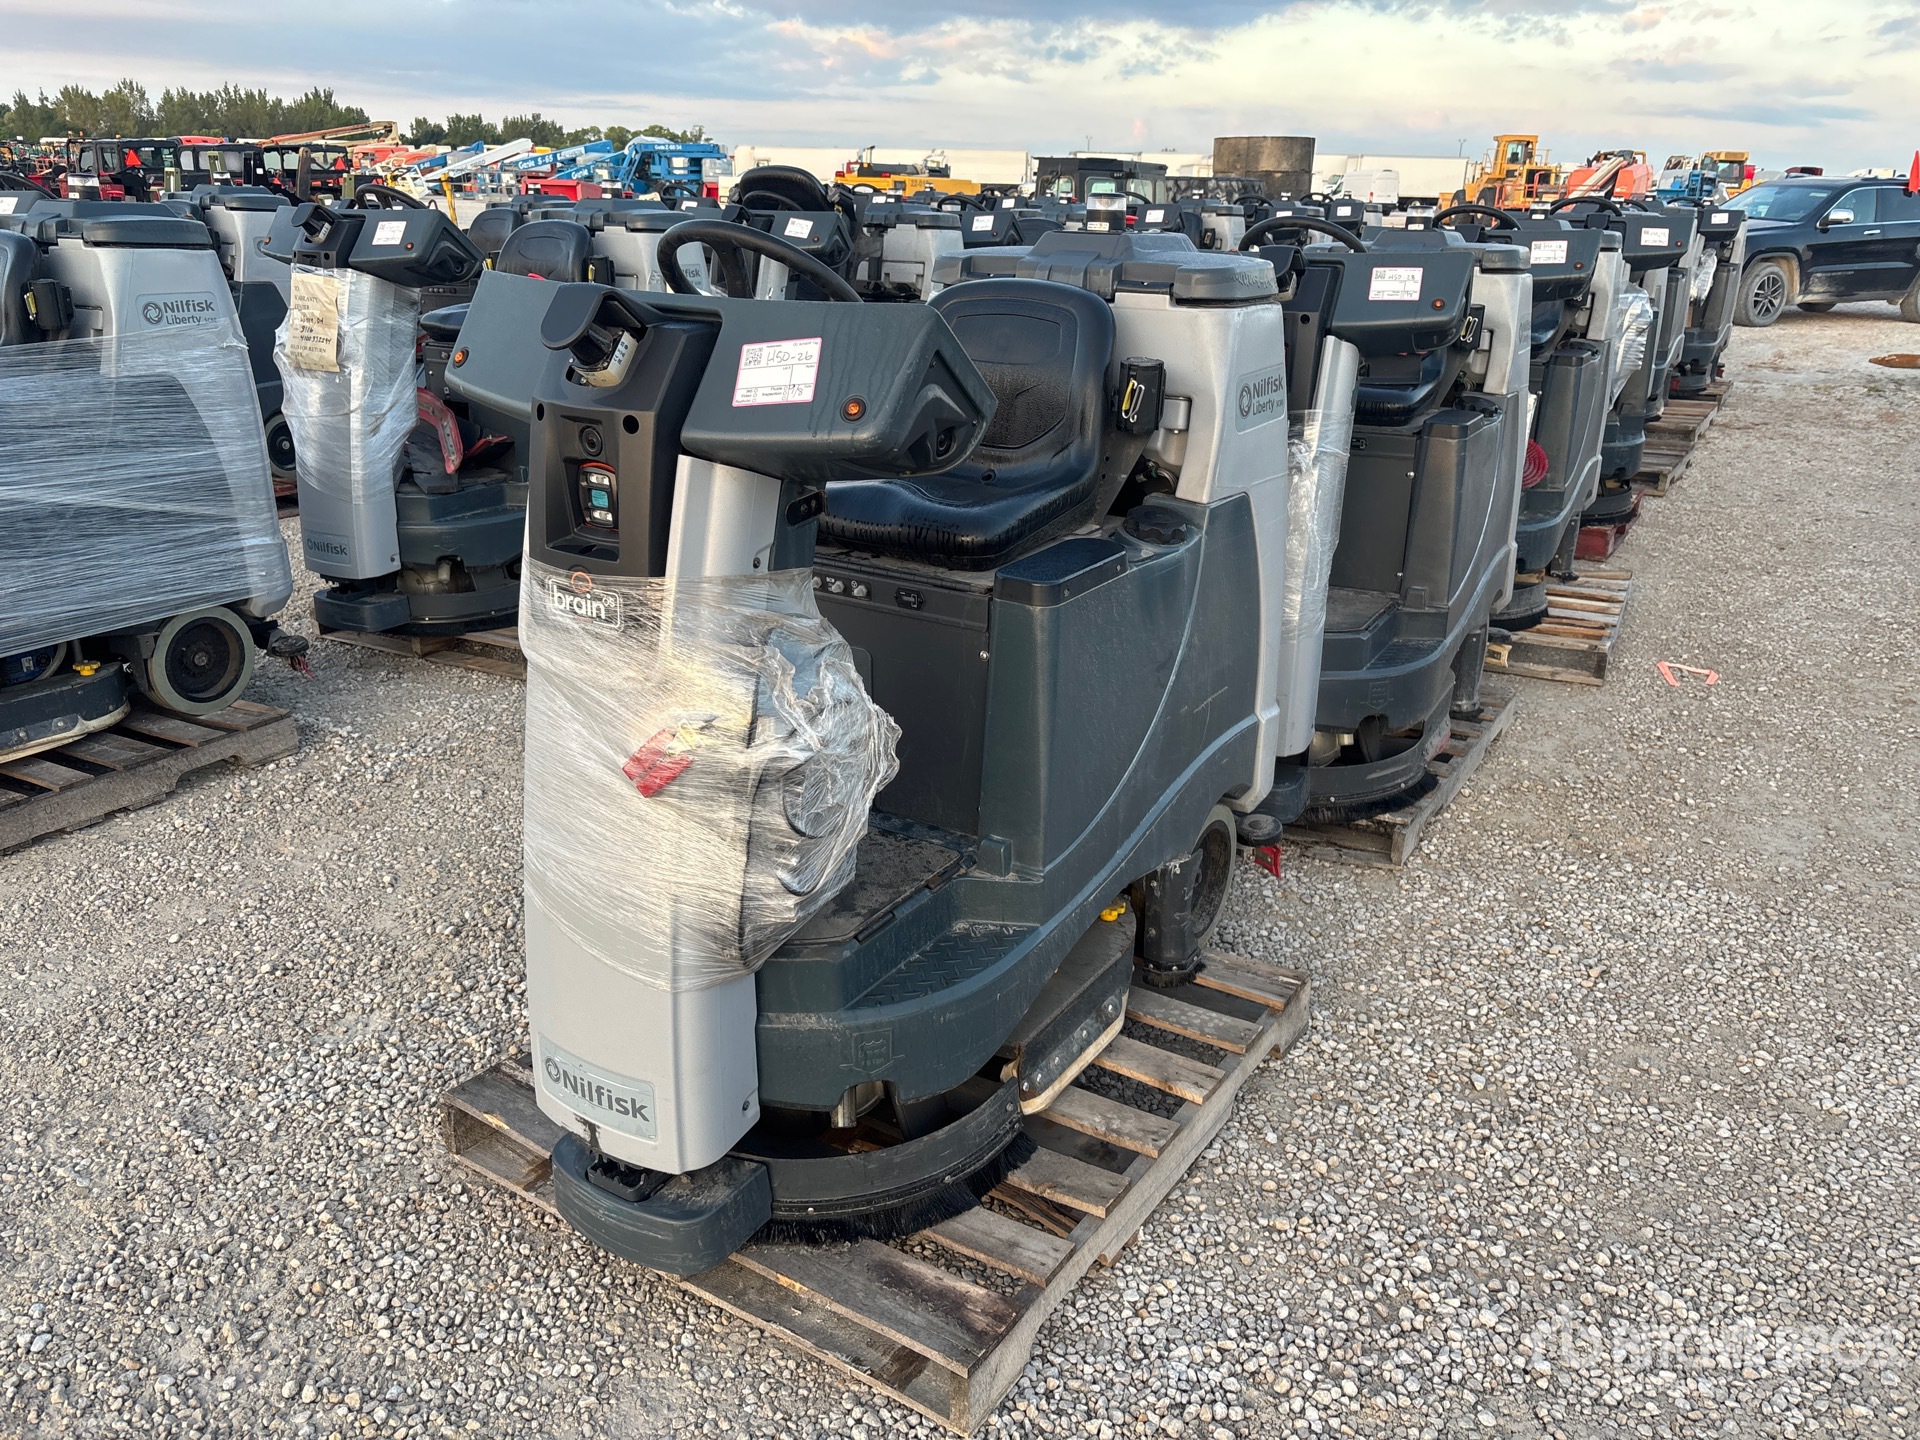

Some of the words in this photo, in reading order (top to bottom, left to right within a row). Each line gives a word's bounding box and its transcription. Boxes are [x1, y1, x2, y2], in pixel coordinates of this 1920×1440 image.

[518, 160, 535, 170] Genie
[571, 168, 589, 180] Genie
[163, 299, 215, 314] Nilfisk
[165, 315, 201, 326] Liberty
[1252, 374, 1284, 400] Nilfisk
[1252, 398, 1275, 416] Liberty
[313, 541, 348, 556] Nilfisk
[562, 1069, 650, 1123] Nilfisk
